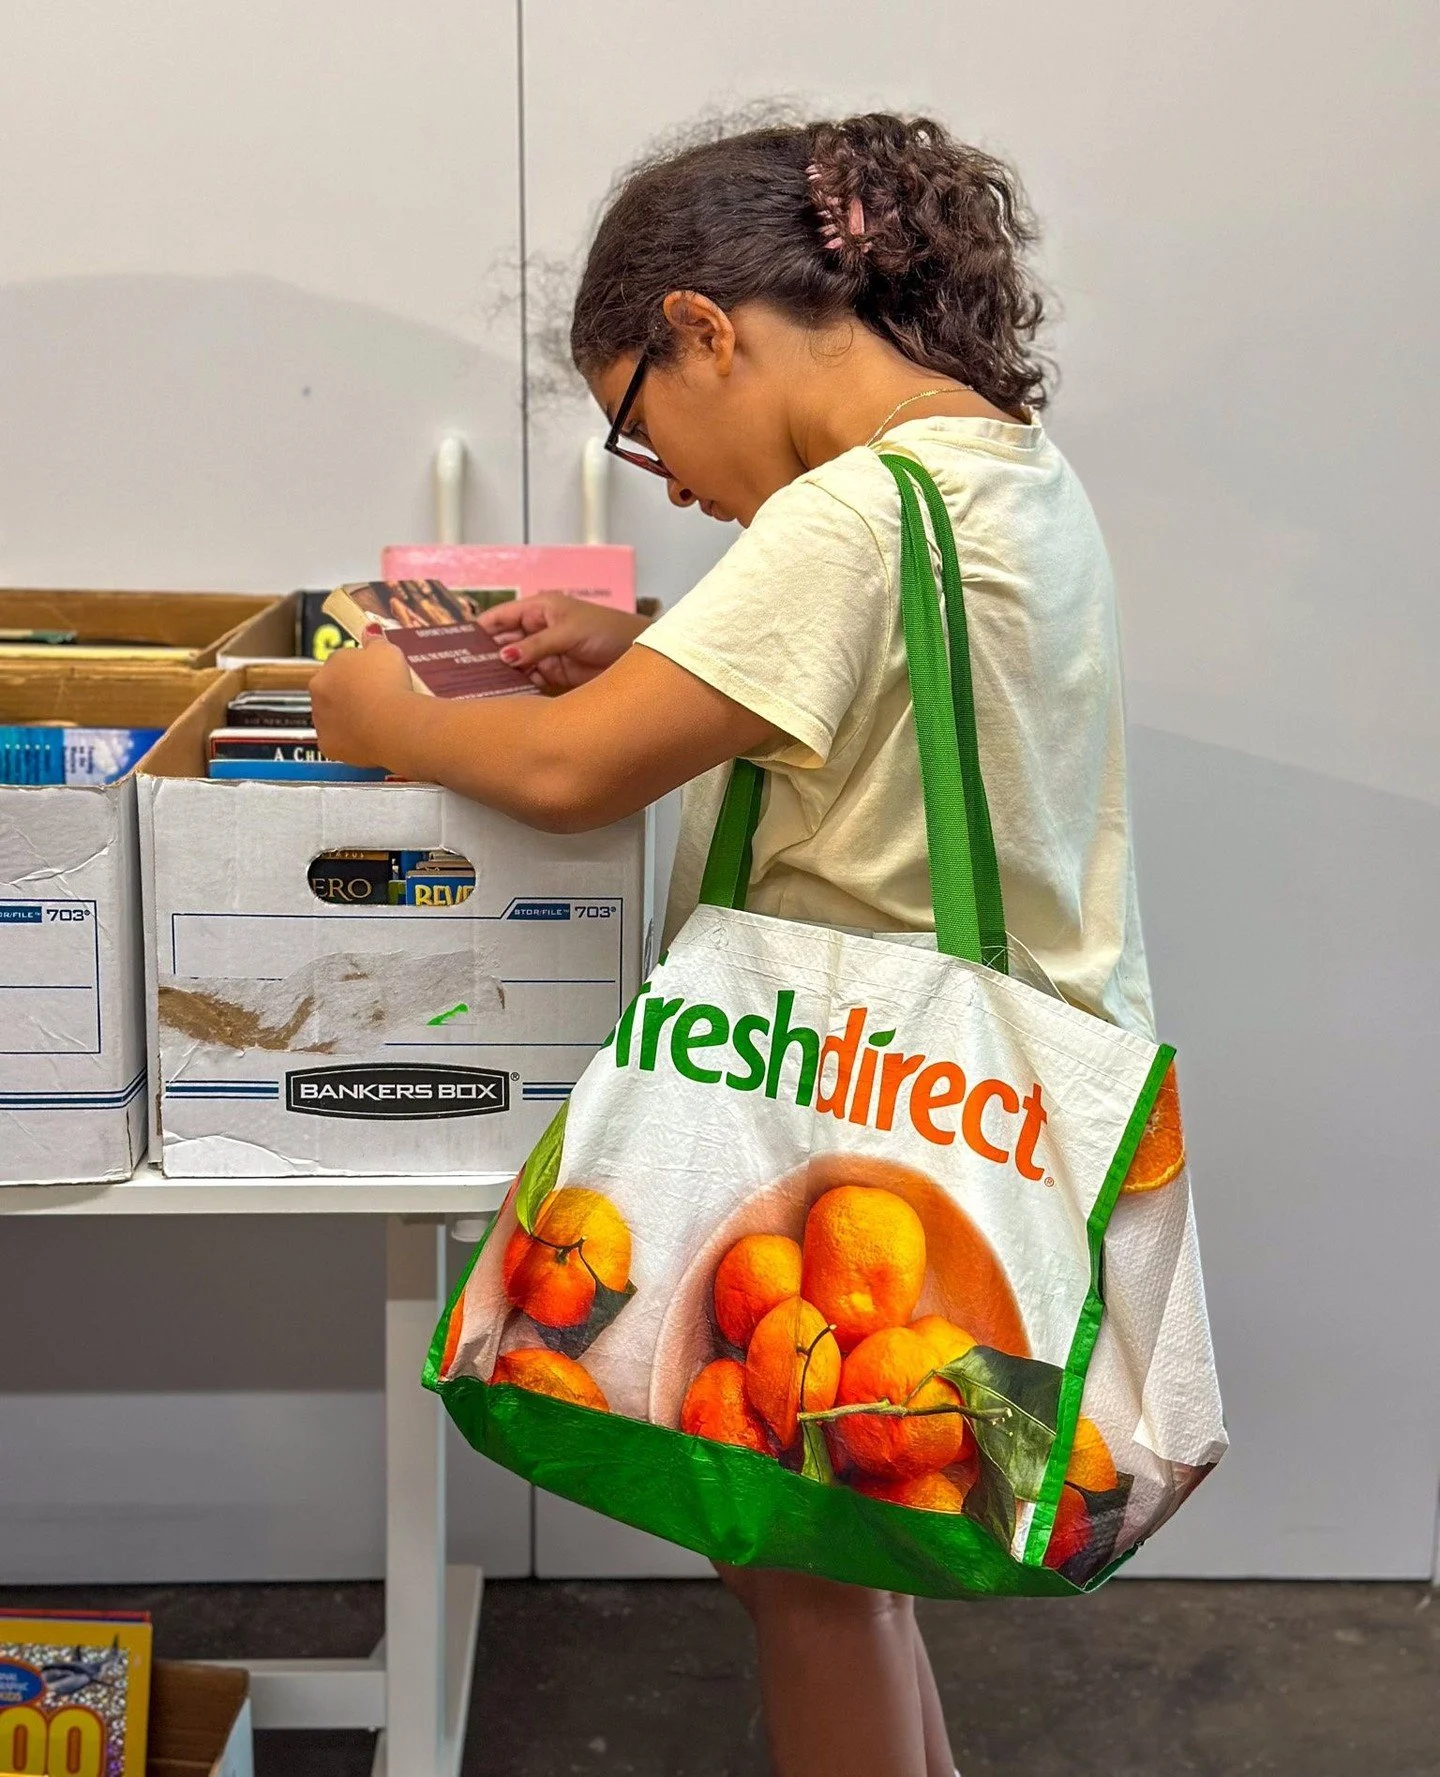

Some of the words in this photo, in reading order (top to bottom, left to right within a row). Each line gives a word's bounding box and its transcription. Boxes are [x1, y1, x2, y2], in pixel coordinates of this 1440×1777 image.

[273, 747, 285, 762] A
[616, 981, 1047, 1181] freshdirect
[300, 1083, 433, 1101] BANKERS
[438, 1083, 498, 1099] BOX
